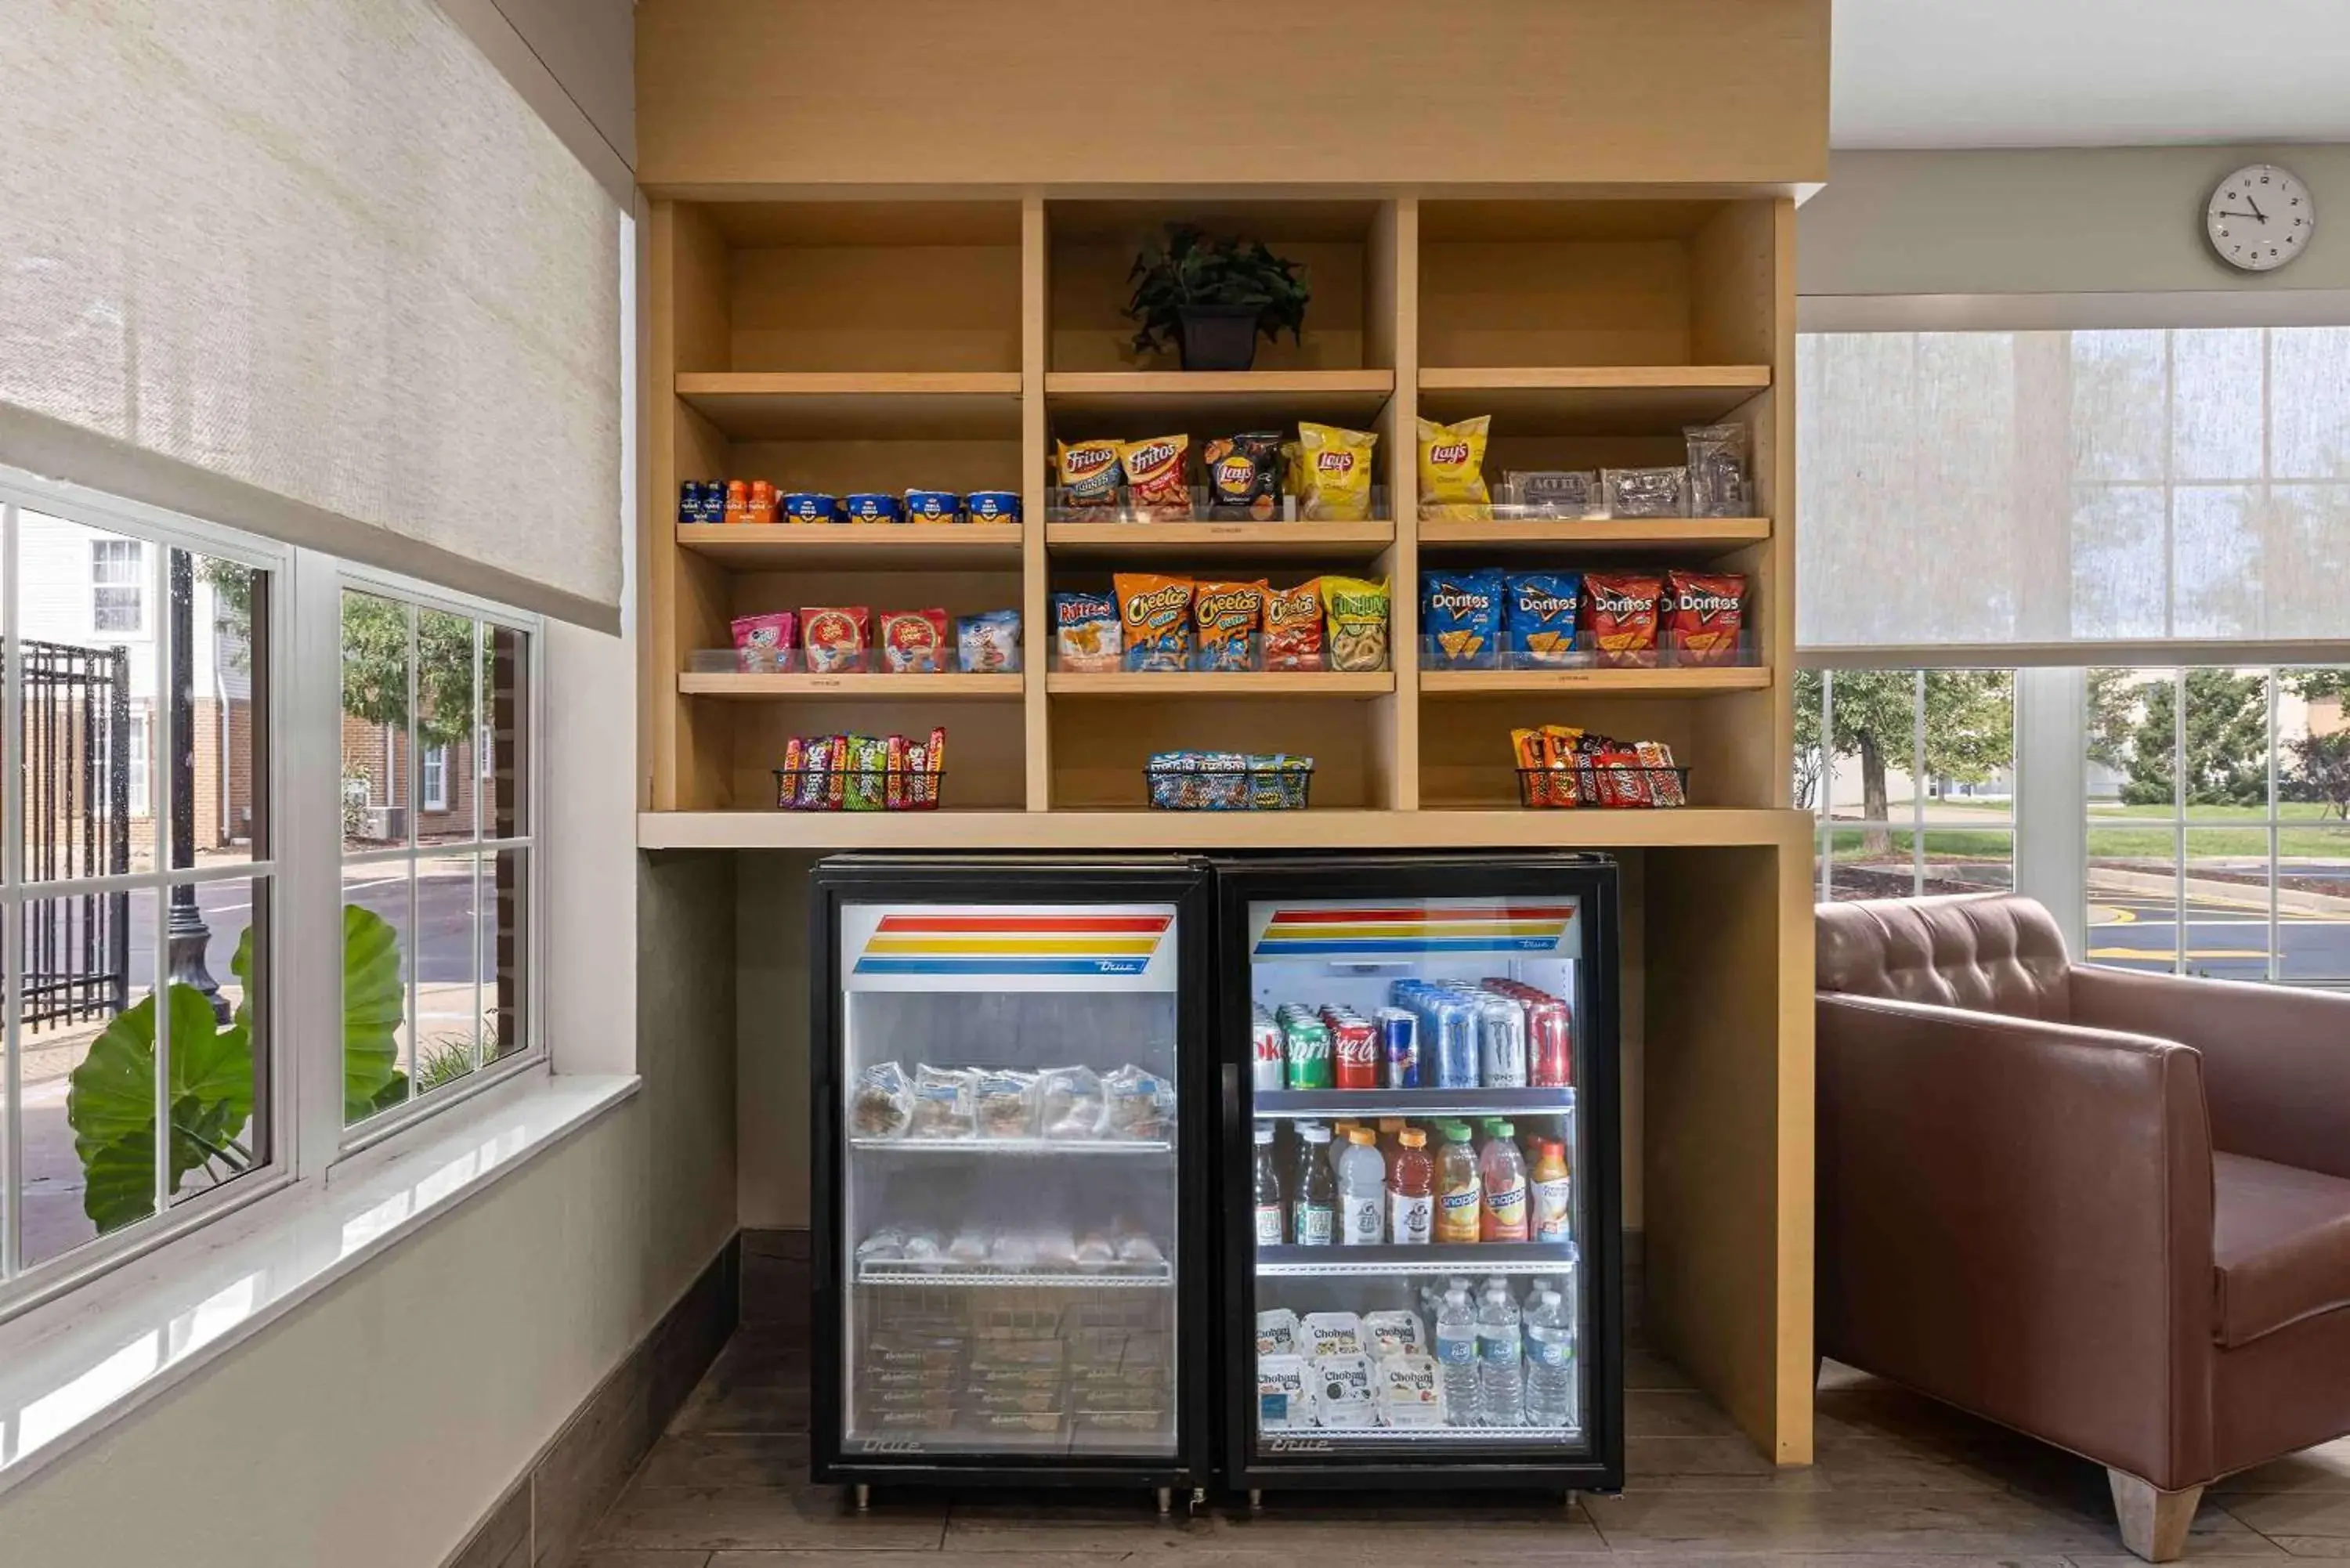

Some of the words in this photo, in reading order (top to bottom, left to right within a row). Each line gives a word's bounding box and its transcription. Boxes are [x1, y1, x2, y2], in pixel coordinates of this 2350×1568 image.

[1065, 449, 1113, 471] Fritos
[1130, 444, 1178, 473] Fritos
[1318, 452, 1353, 470] Lay's
[1432, 443, 1467, 464] Lay's
[1220, 465, 1252, 484] Lay's
[1128, 586, 1189, 626] Cheetos
[1196, 591, 1262, 627] Cheetos
[1270, 596, 1314, 623] Cheetos
[1433, 594, 1488, 609] Doritos
[1520, 597, 1576, 612] Doritos
[1596, 597, 1653, 611] Doritos
[1680, 596, 1739, 610] Doritos
[1314, 1327, 1354, 1339] Chobani
[1325, 1370, 1367, 1382] Chobani
[1390, 1371, 1433, 1383] Chobani
